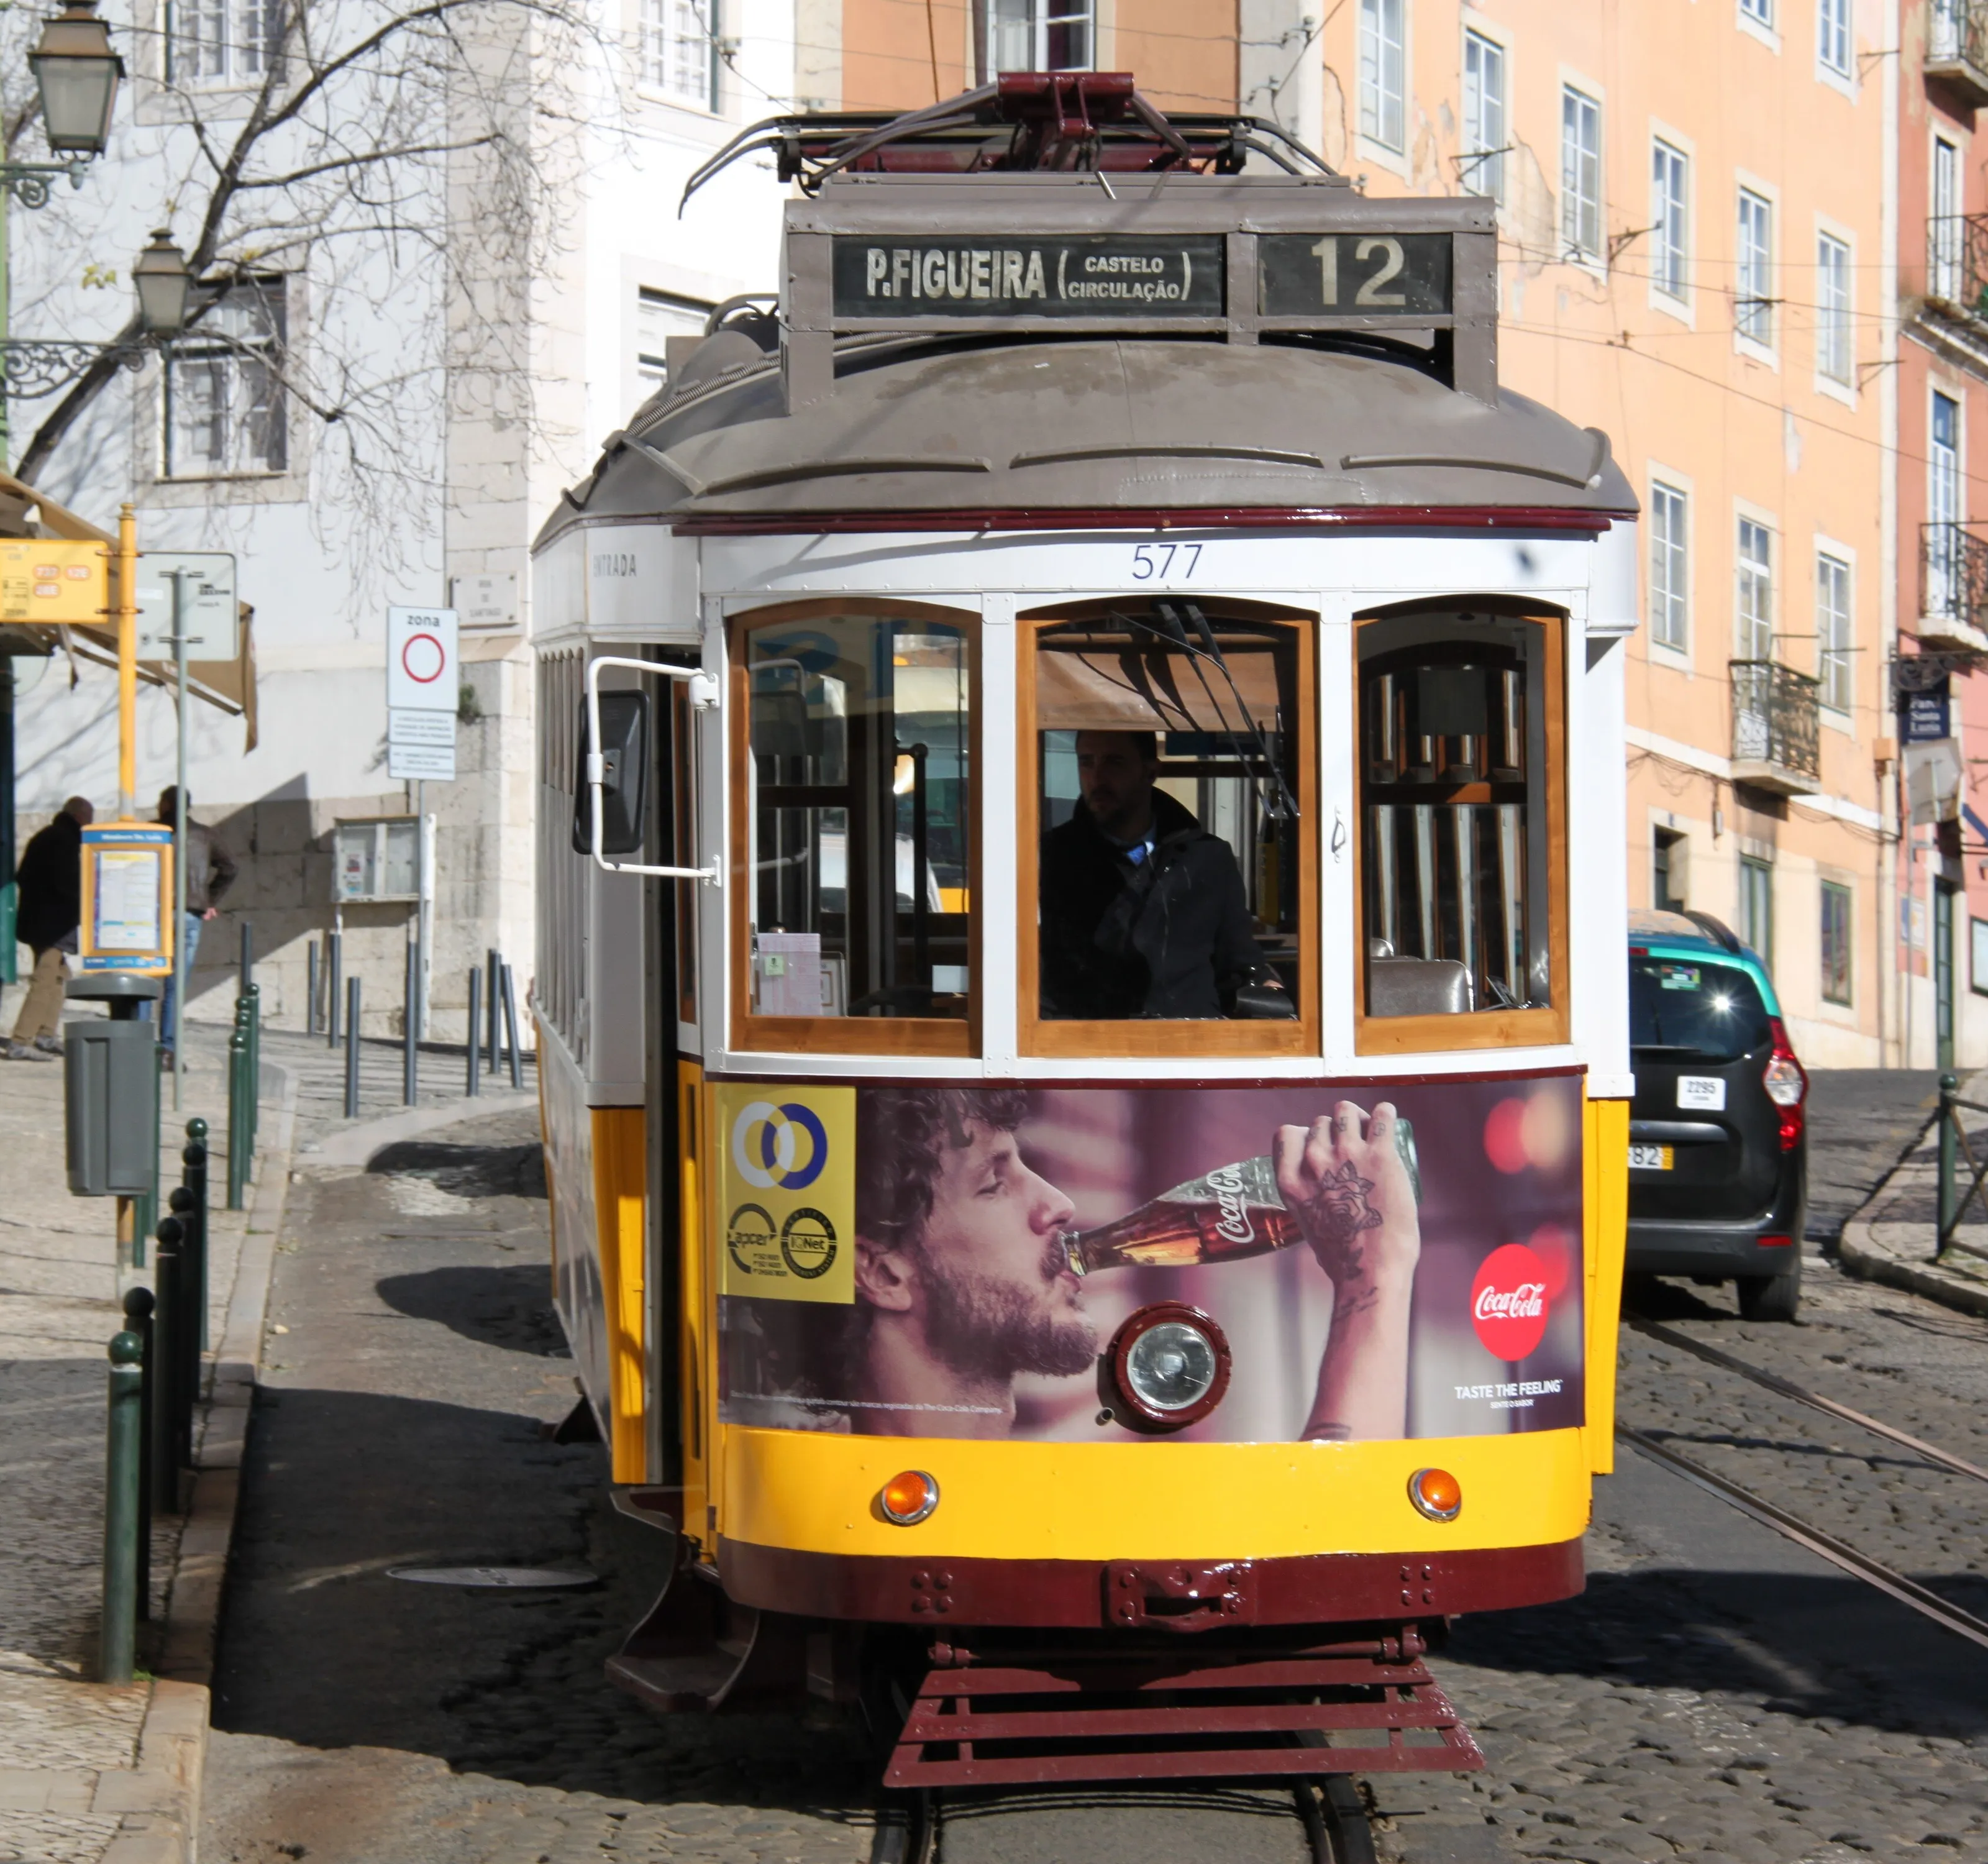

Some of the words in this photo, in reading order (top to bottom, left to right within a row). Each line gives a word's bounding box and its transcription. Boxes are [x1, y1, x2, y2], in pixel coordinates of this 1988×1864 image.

[867, 248, 1047, 298] P.FIGUEIRA
[1311, 235, 1407, 305] 12
[1132, 544, 1203, 580] 577
[407, 614, 440, 627] zona
[1475, 1283, 1546, 1320] Coca-Cola
[1454, 1385, 1493, 1399] TASTE
[1495, 1383, 1518, 1397] THE
